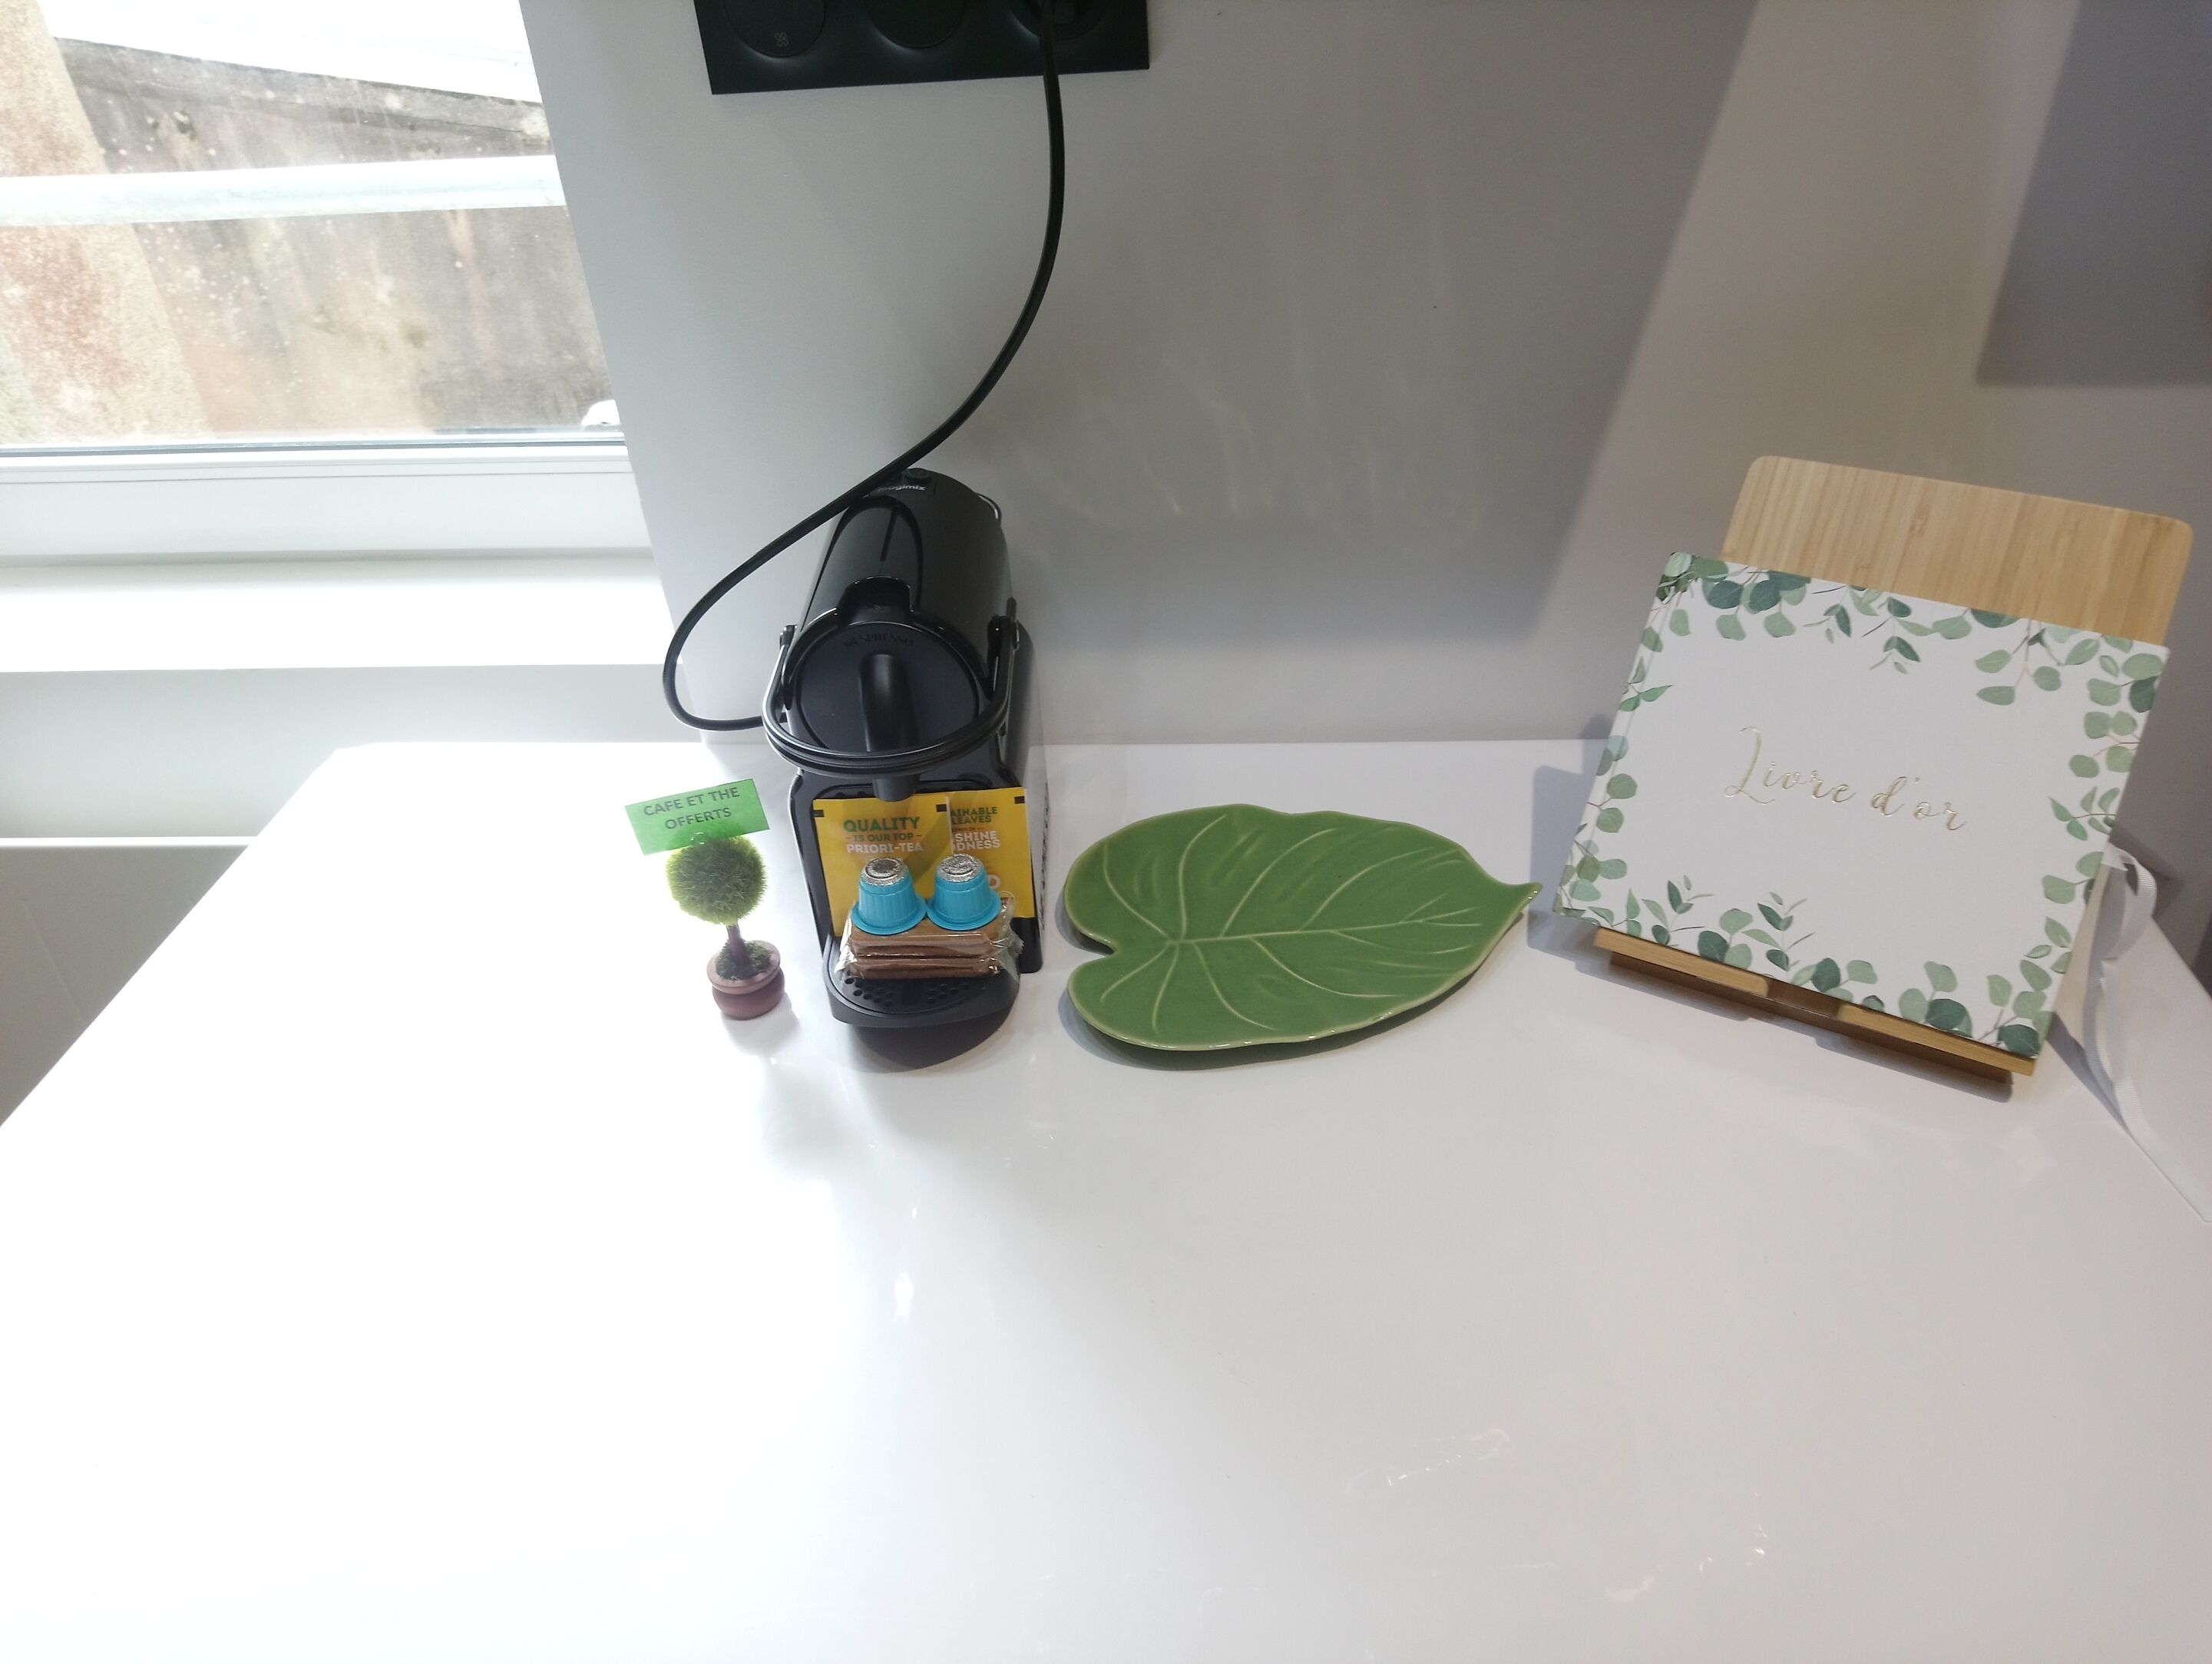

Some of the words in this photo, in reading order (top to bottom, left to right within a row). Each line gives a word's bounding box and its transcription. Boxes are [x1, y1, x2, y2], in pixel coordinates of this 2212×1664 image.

[1724, 726, 1857, 806] Livre
[643, 799, 684, 815] CAFE
[686, 793, 704, 806] ET
[708, 786, 740, 802] THE
[951, 806, 998, 816] AINABLE
[665, 807, 732, 829] OFFERTS
[843, 816, 921, 832] QUALITY
[867, 833, 891, 842] OUR
[892, 832, 914, 841] TOP
[954, 831, 997, 842] SHINE
[846, 842, 924, 853] PRIORI-TEA
[953, 839, 1001, 851] DNESS
